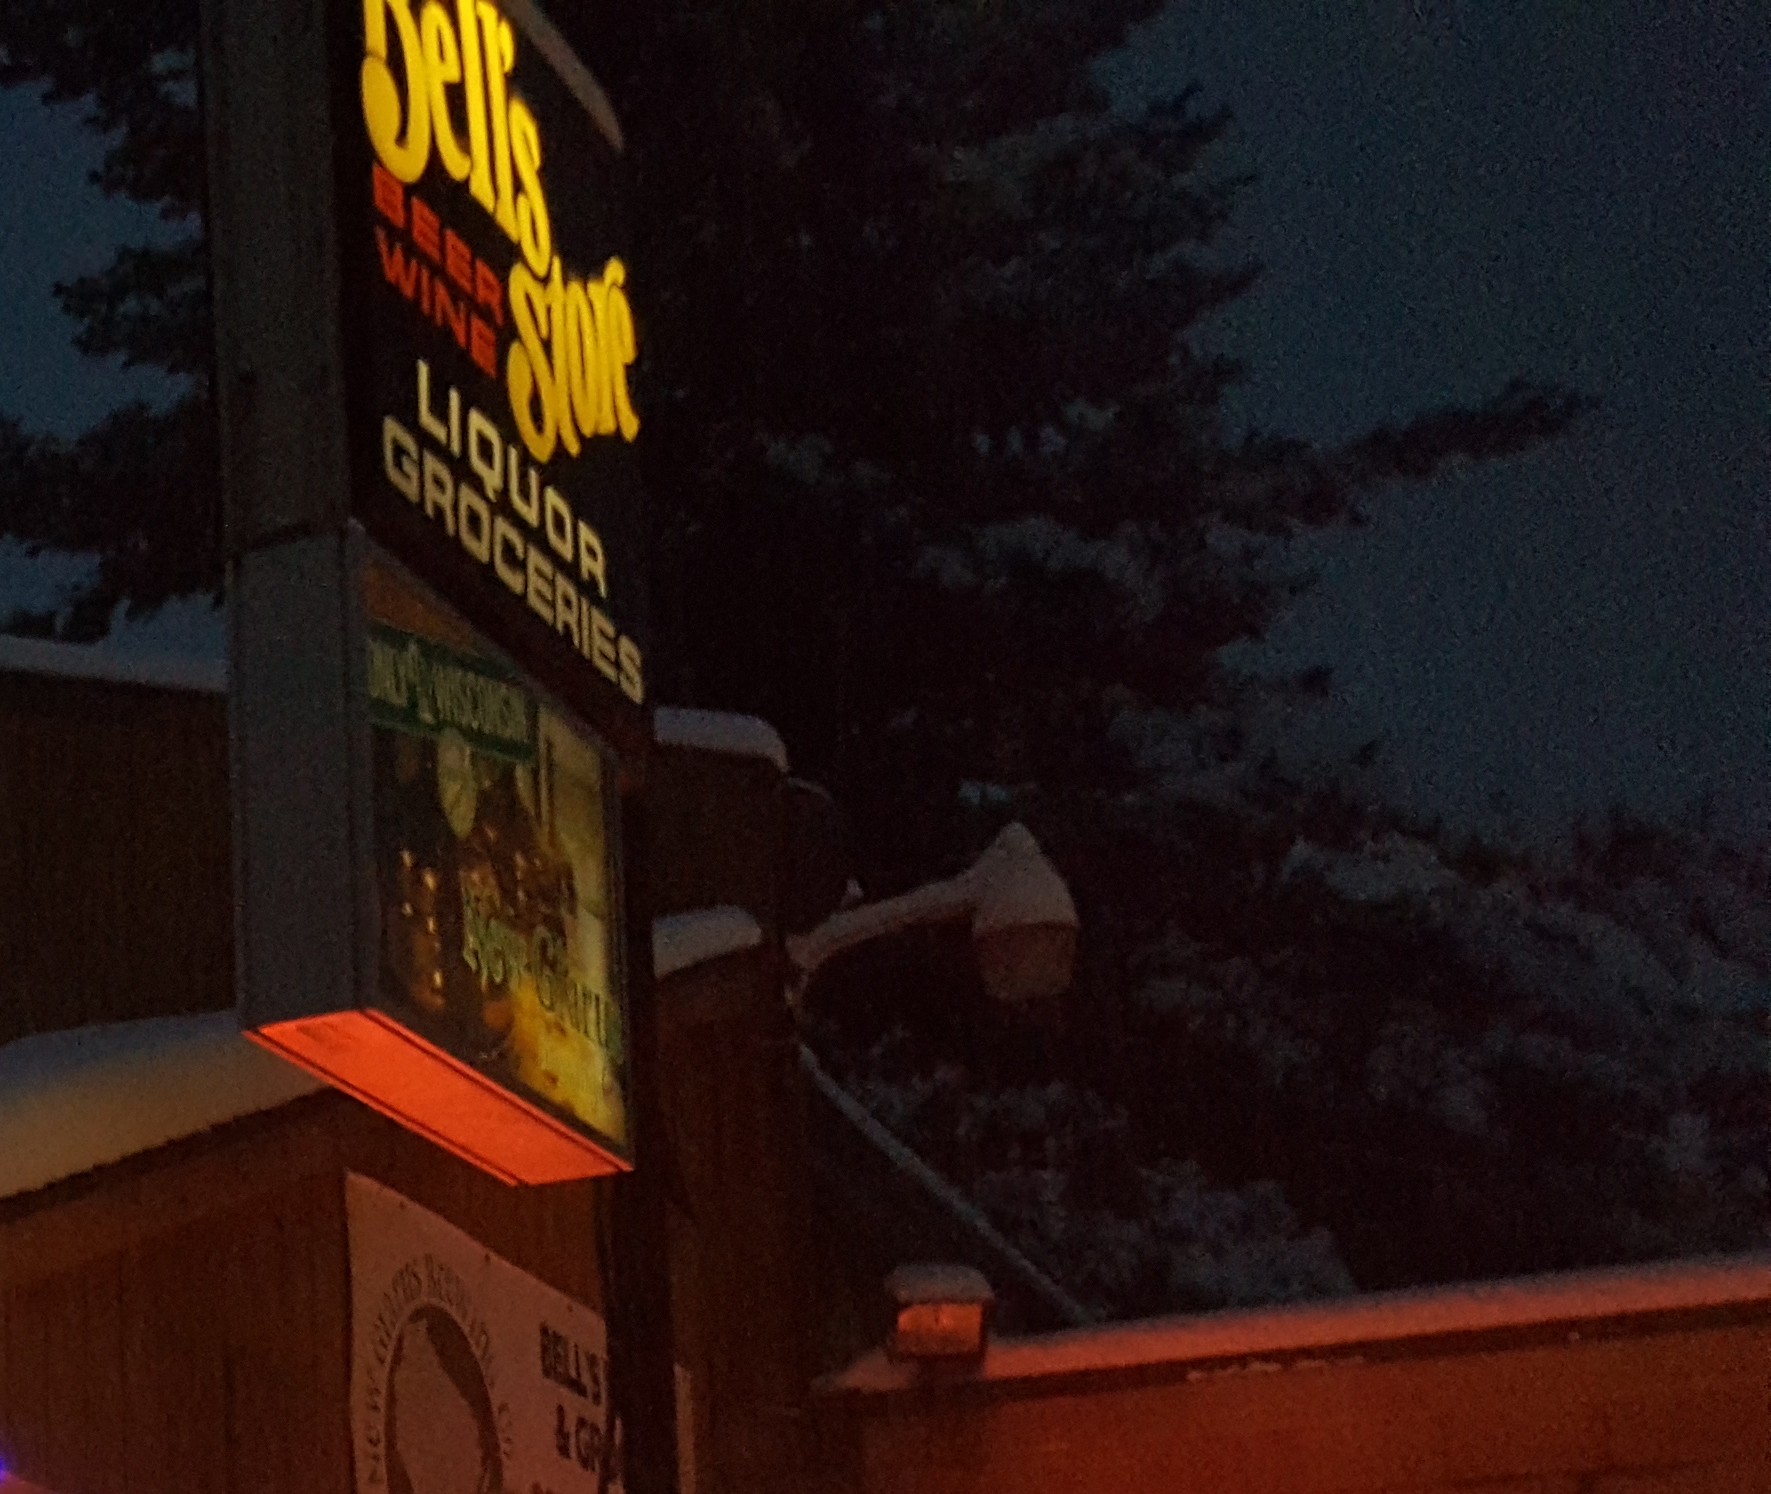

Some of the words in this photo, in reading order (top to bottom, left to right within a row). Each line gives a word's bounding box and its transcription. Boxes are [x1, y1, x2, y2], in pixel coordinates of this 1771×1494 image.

[372, 162, 502, 326] BEER
[376, 227, 495, 378] WINE
[507, 255, 640, 463] Store
[382, 415, 644, 700] GROCERIES
[417, 358, 606, 598] LIQUOR
